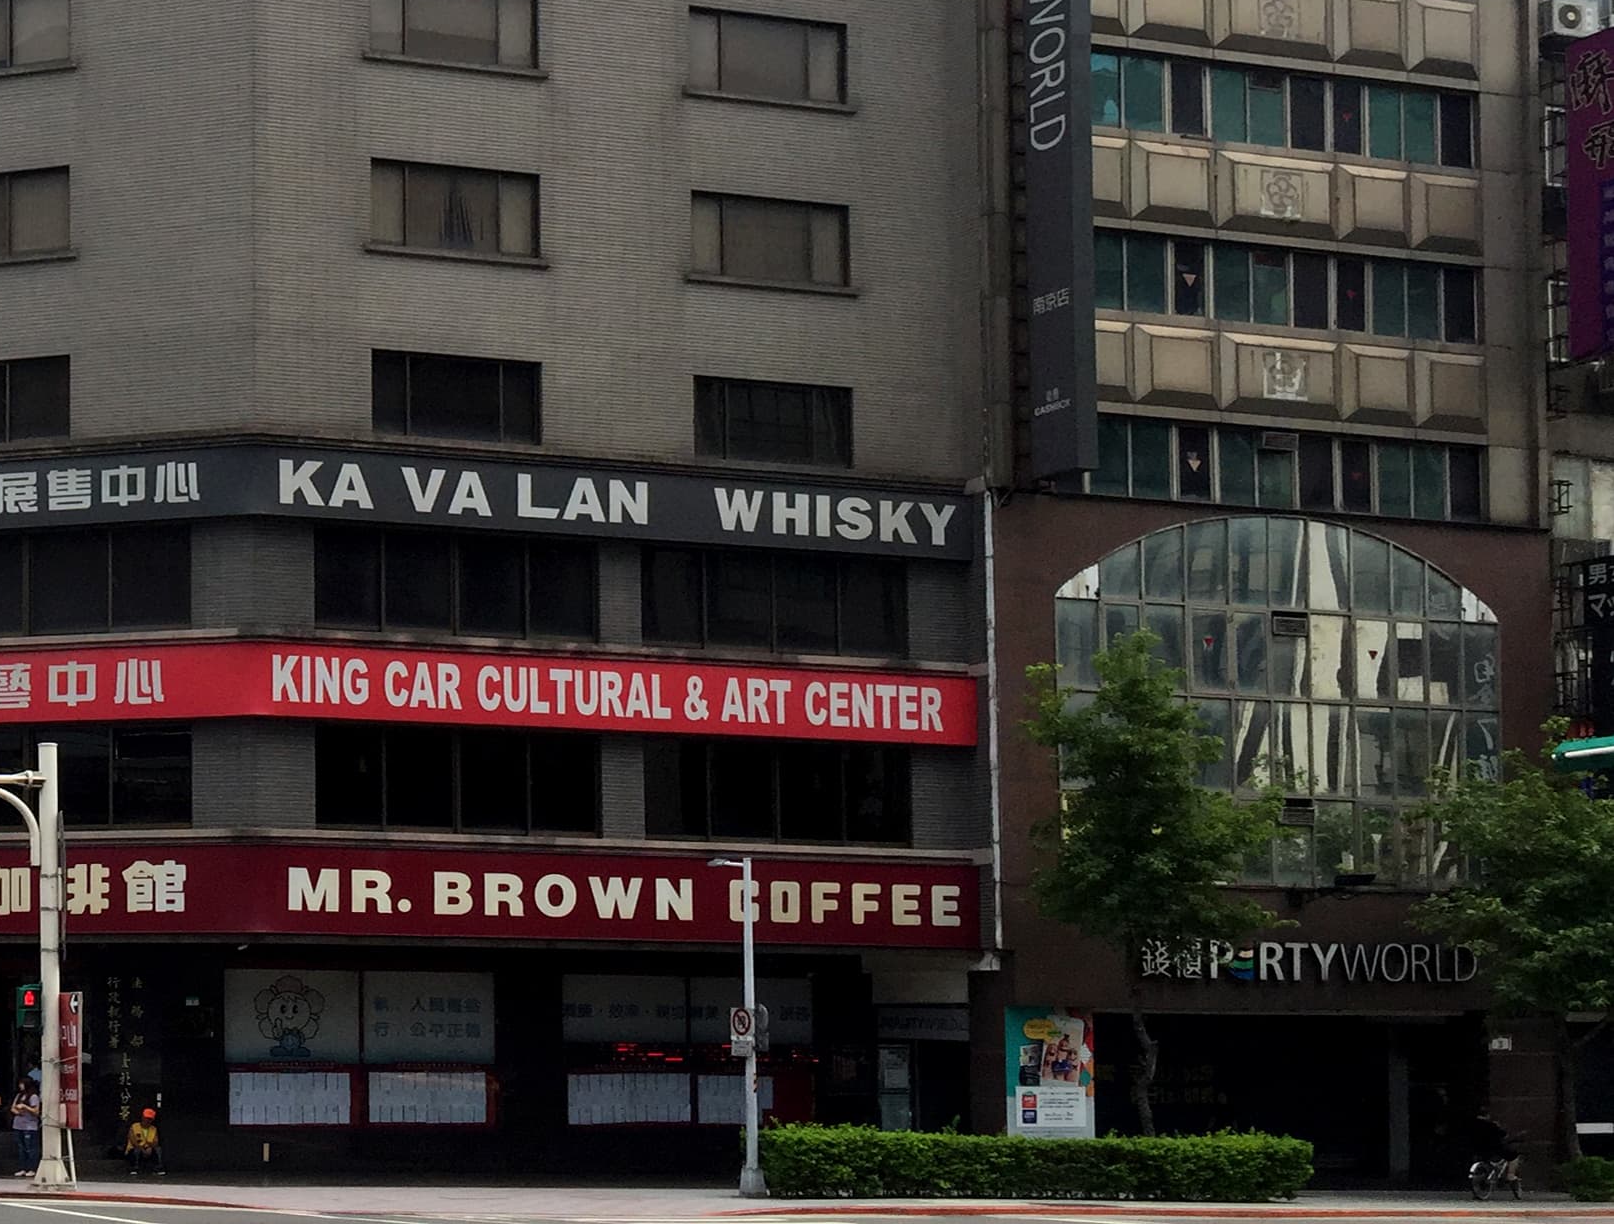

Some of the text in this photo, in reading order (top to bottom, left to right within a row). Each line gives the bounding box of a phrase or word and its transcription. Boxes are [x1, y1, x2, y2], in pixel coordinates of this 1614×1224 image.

[278, 459, 957, 546] KA VA LAN WHISKY
[272, 654, 943, 733] KING CAR CULTURAL & ART CENTER
[287, 867, 961, 927] MR. BROWN COFFEE
